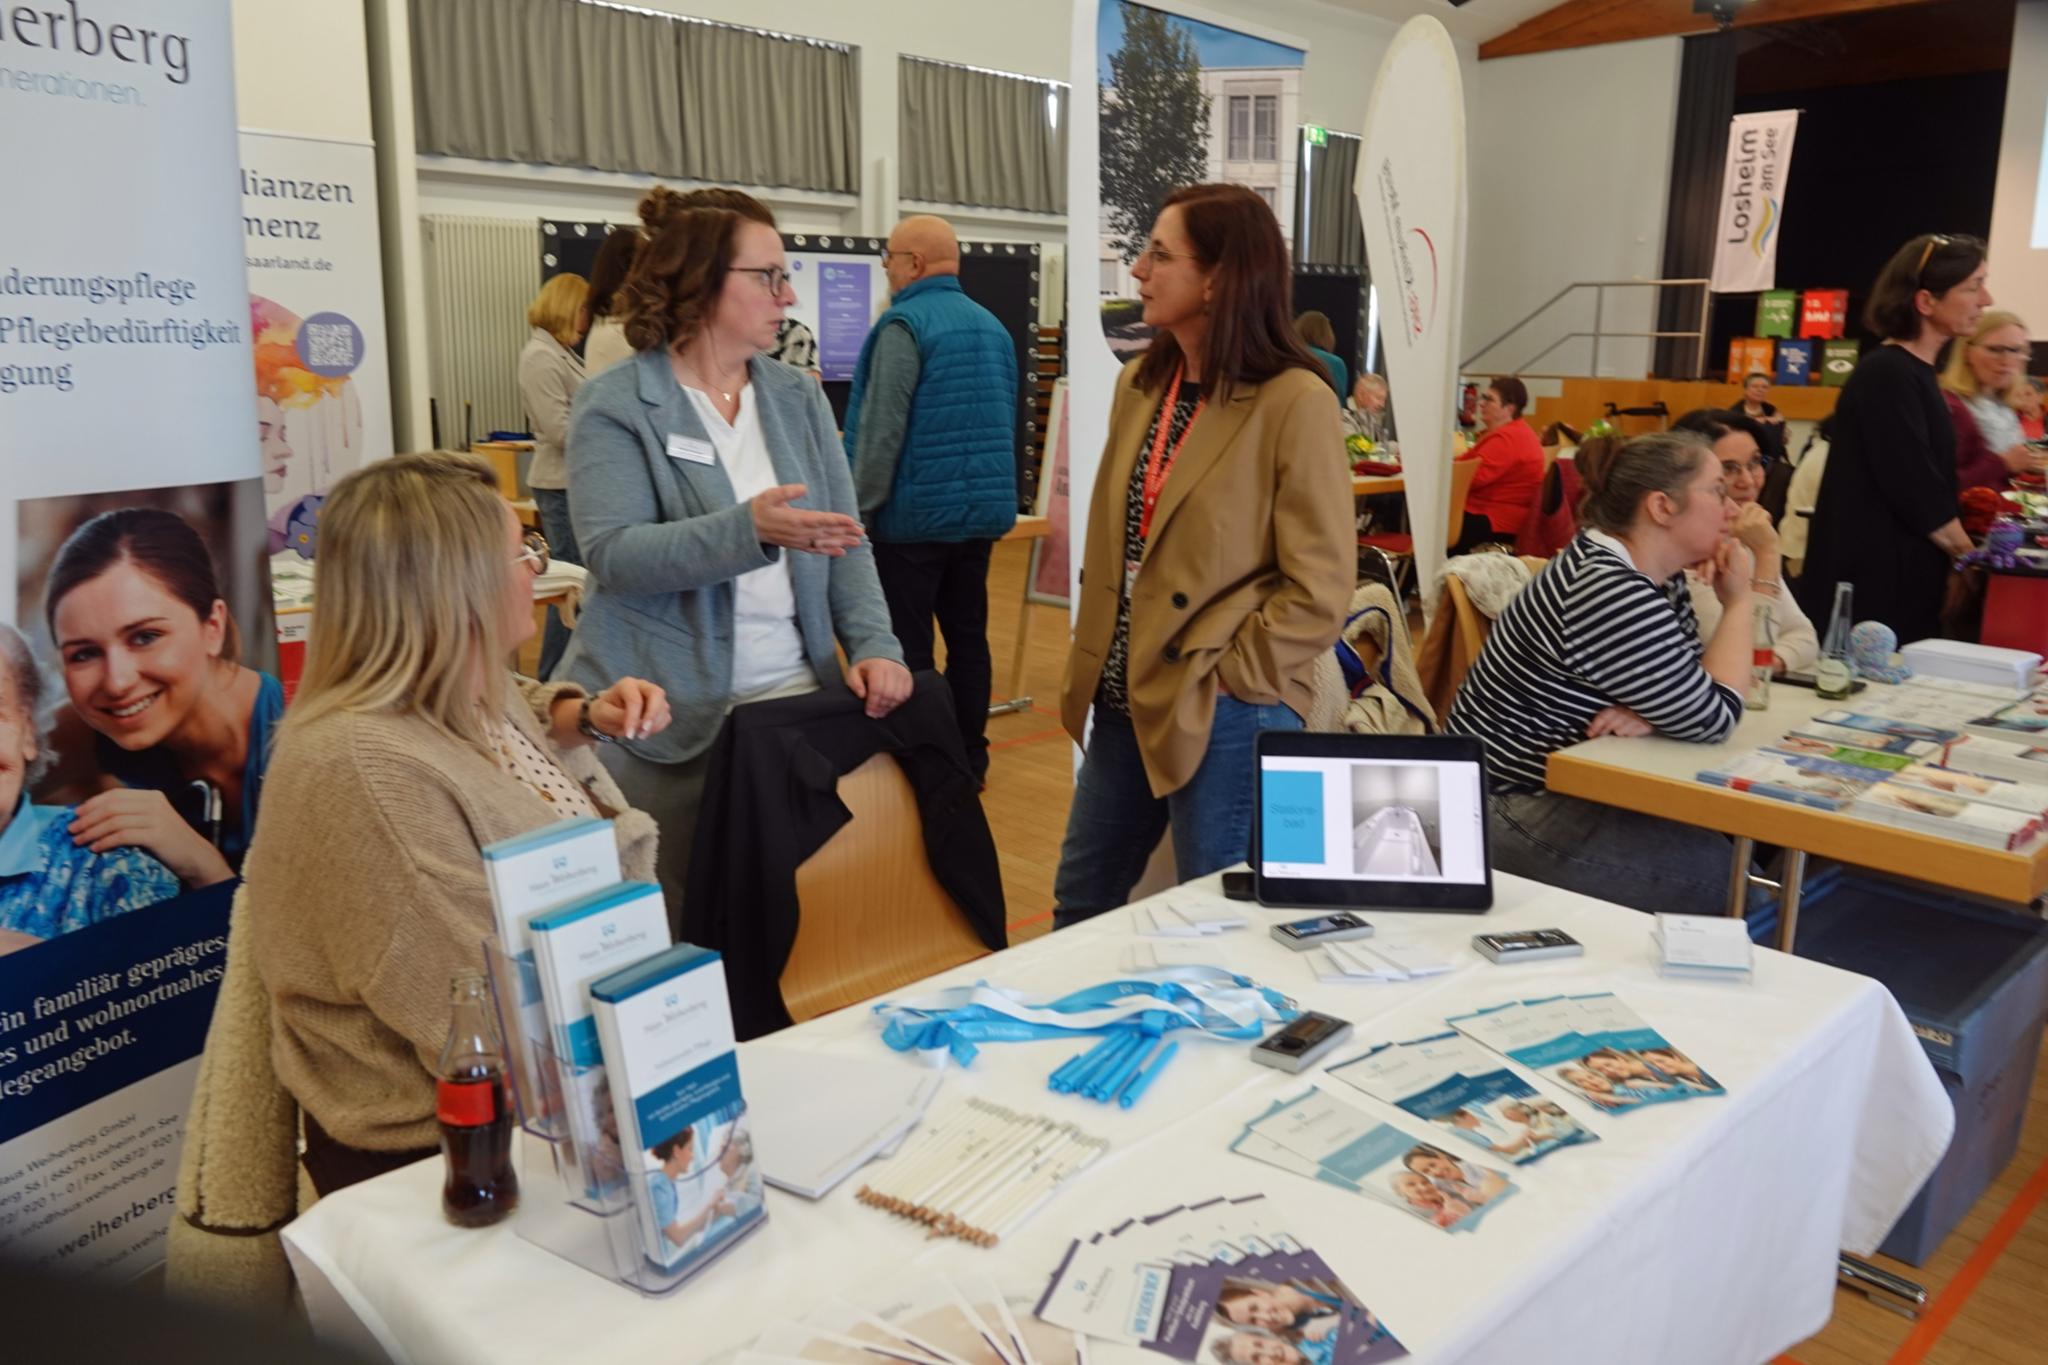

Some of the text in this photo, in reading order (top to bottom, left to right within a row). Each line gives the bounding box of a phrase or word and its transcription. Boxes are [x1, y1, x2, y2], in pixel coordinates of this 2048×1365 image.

[0, 0, 192, 85] erberg
[1727, 128, 1760, 244] Losheim
[1761, 127, 1779, 192] am See
[0, 267, 197, 306] derungspflege
[23, 1019, 70, 1055] und
[75, 964, 224, 1033] wohnortnahes
[33, 971, 123, 1020] familiär
